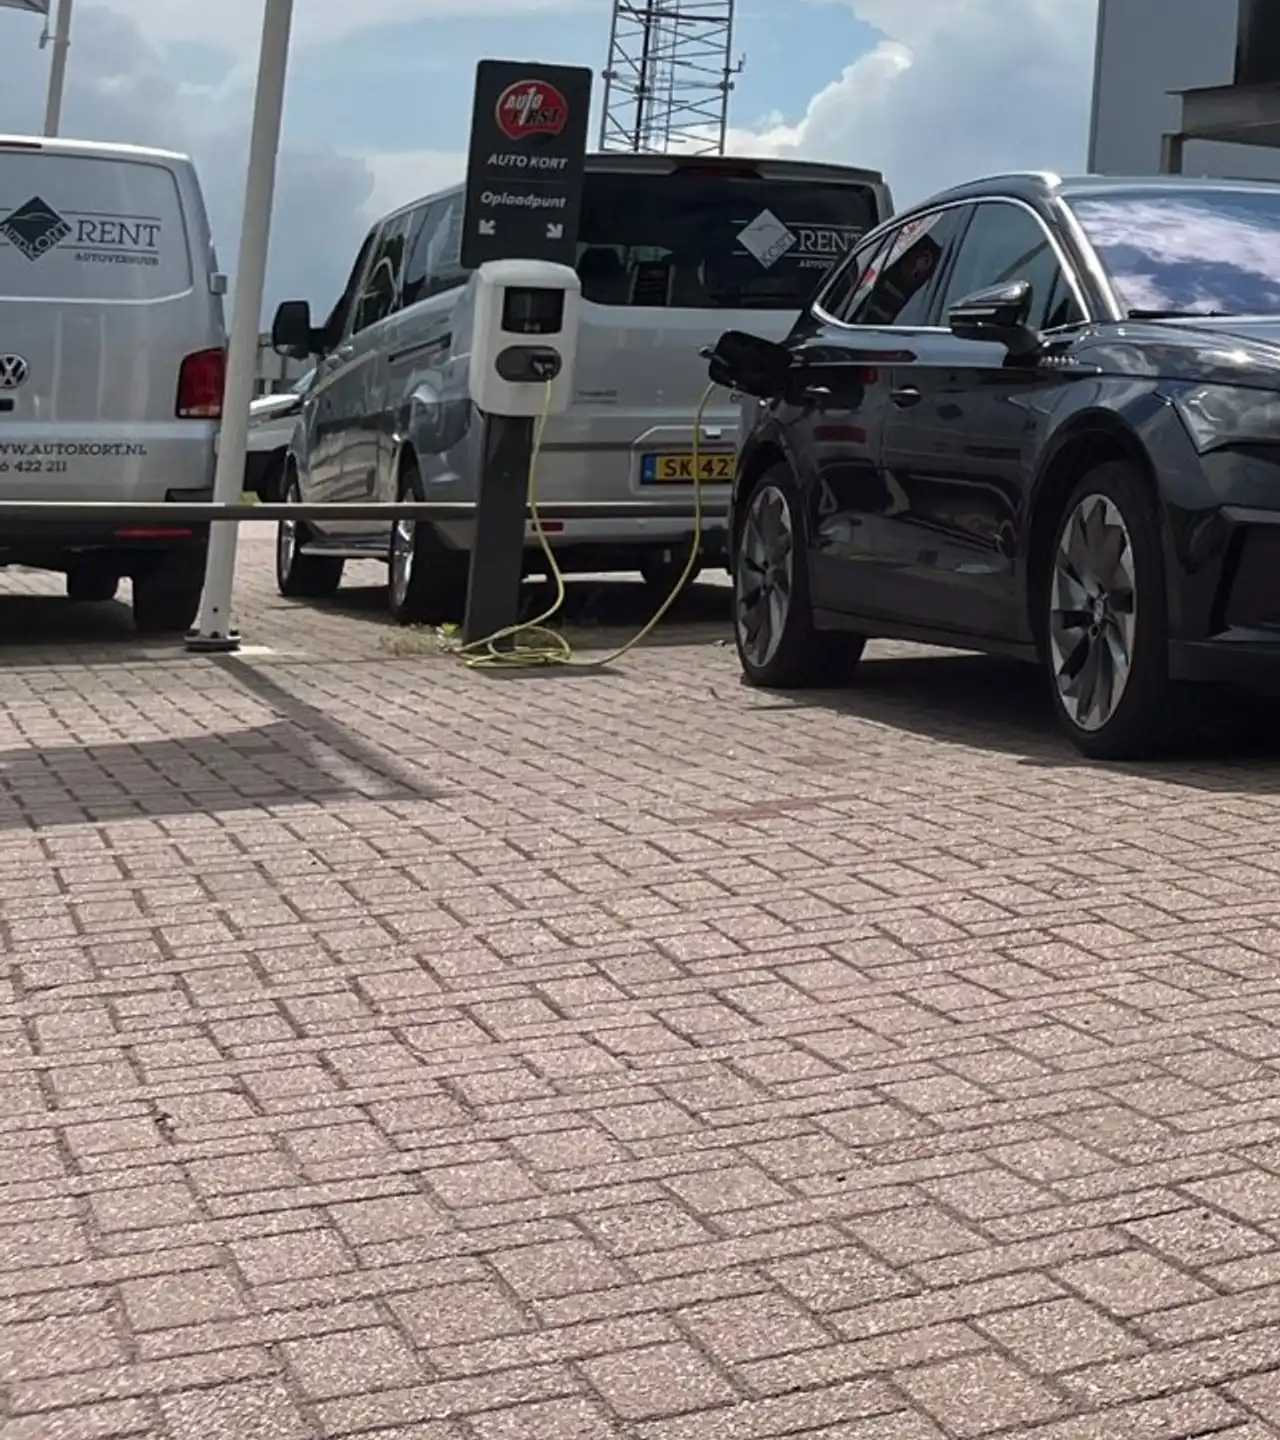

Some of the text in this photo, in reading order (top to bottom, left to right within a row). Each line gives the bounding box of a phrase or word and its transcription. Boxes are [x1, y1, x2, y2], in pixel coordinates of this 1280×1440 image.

[504, 90, 544, 111] AUTO
[488, 153, 568, 170] AUTO KORT
[481, 191, 567, 209] Oplaadpunt
[77, 219, 161, 247] RENT
[14, 460, 42, 472] 422
